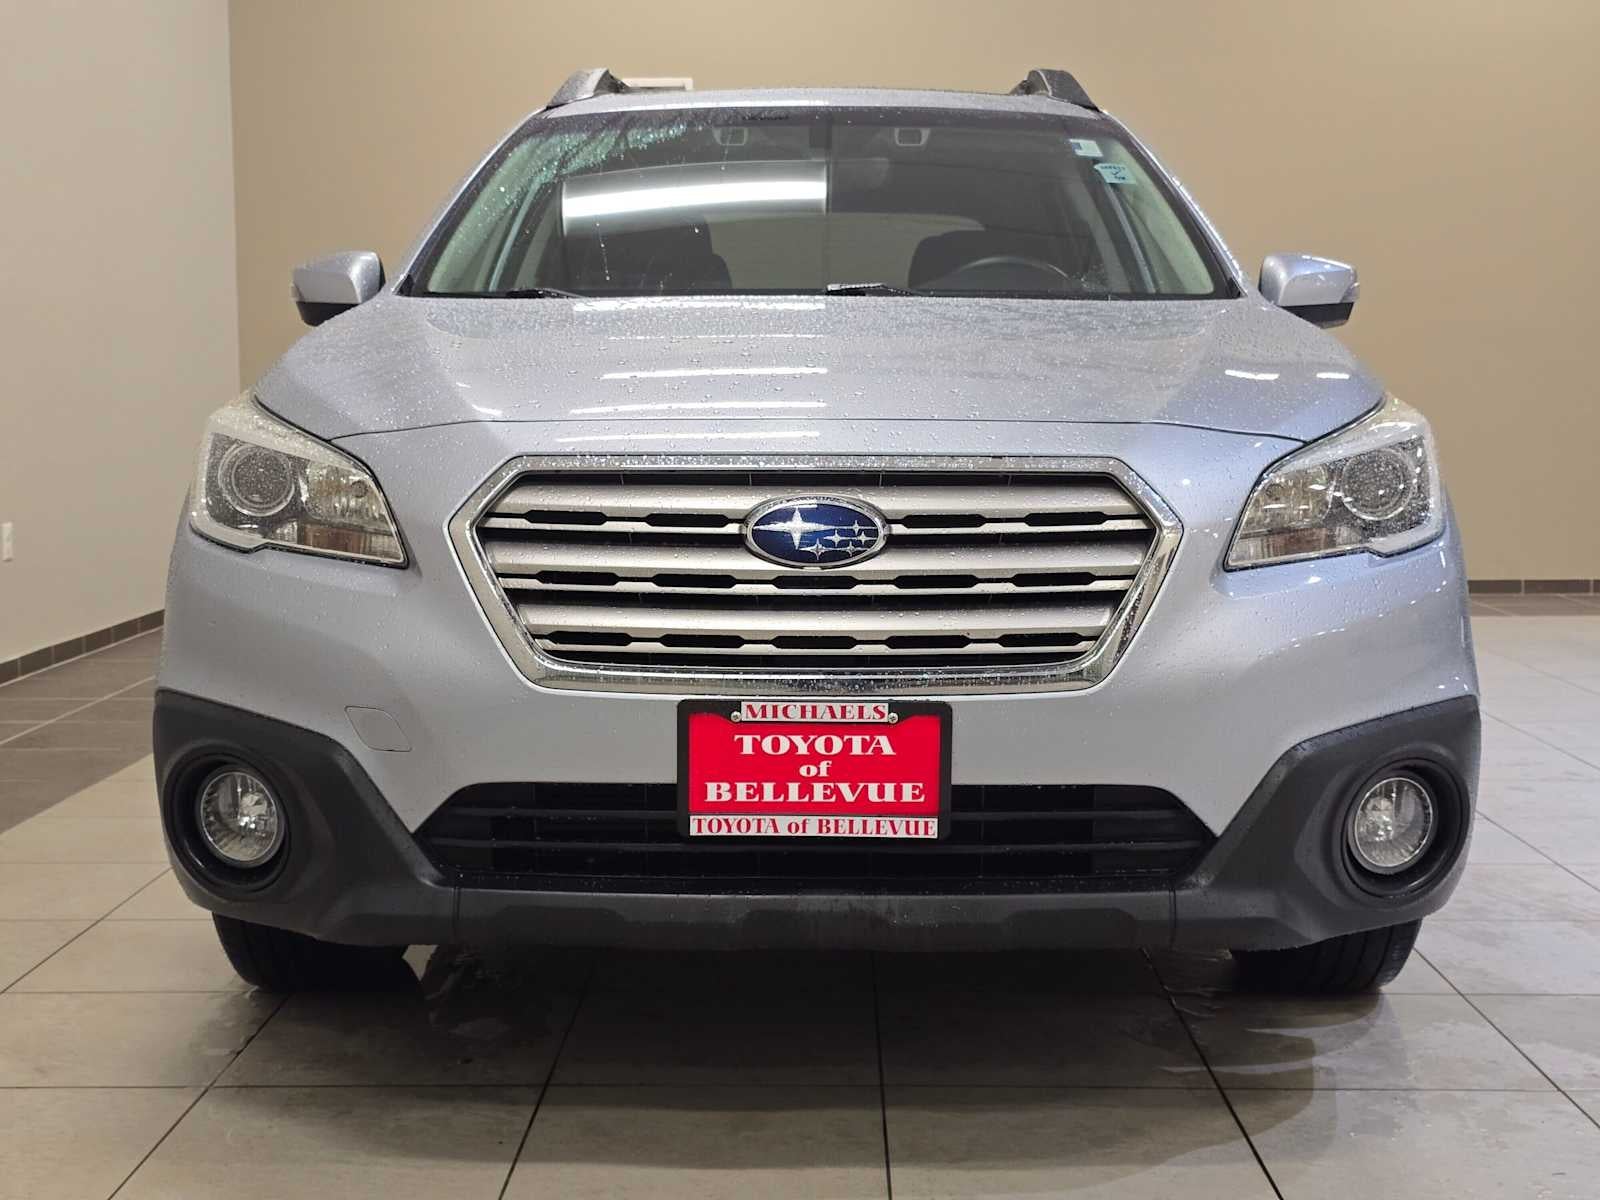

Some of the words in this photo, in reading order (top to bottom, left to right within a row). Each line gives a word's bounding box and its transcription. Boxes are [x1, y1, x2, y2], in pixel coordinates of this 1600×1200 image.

[745, 704, 886, 720] MICHAELS
[734, 735, 896, 755] TOYOTA
[799, 761, 832, 777] of
[704, 782, 925, 803] BELLEVUE
[692, 818, 780, 834] TOYOTA
[787, 818, 809, 834] of
[818, 818, 936, 836] BELLEVUE
